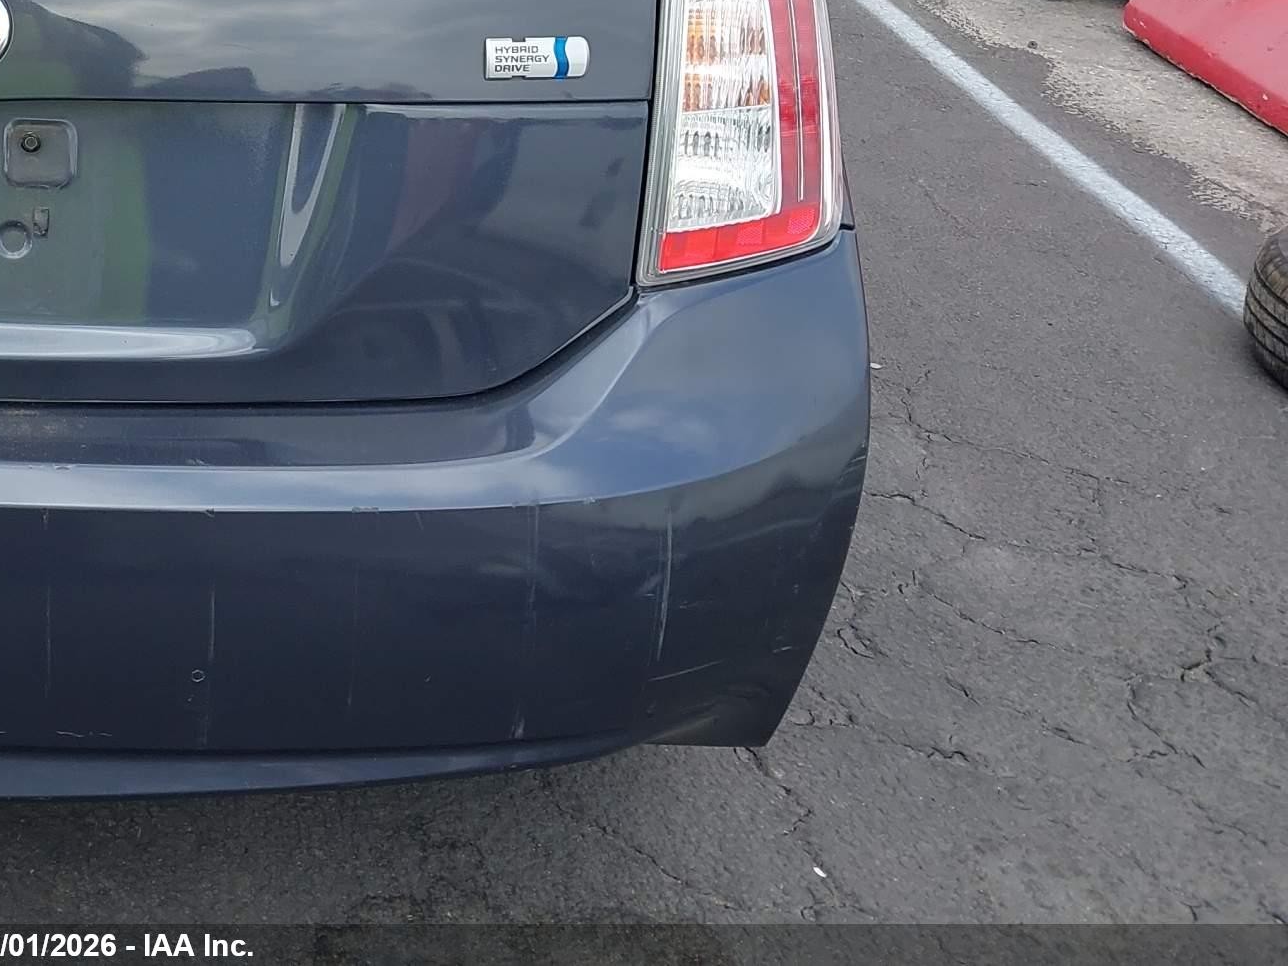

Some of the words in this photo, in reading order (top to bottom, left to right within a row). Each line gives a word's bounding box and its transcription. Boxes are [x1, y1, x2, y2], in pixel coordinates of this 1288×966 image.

[495, 45, 539, 54] HYBRID
[495, 54, 550, 64] SYNERGY
[494, 64, 531, 73] DRIVE
